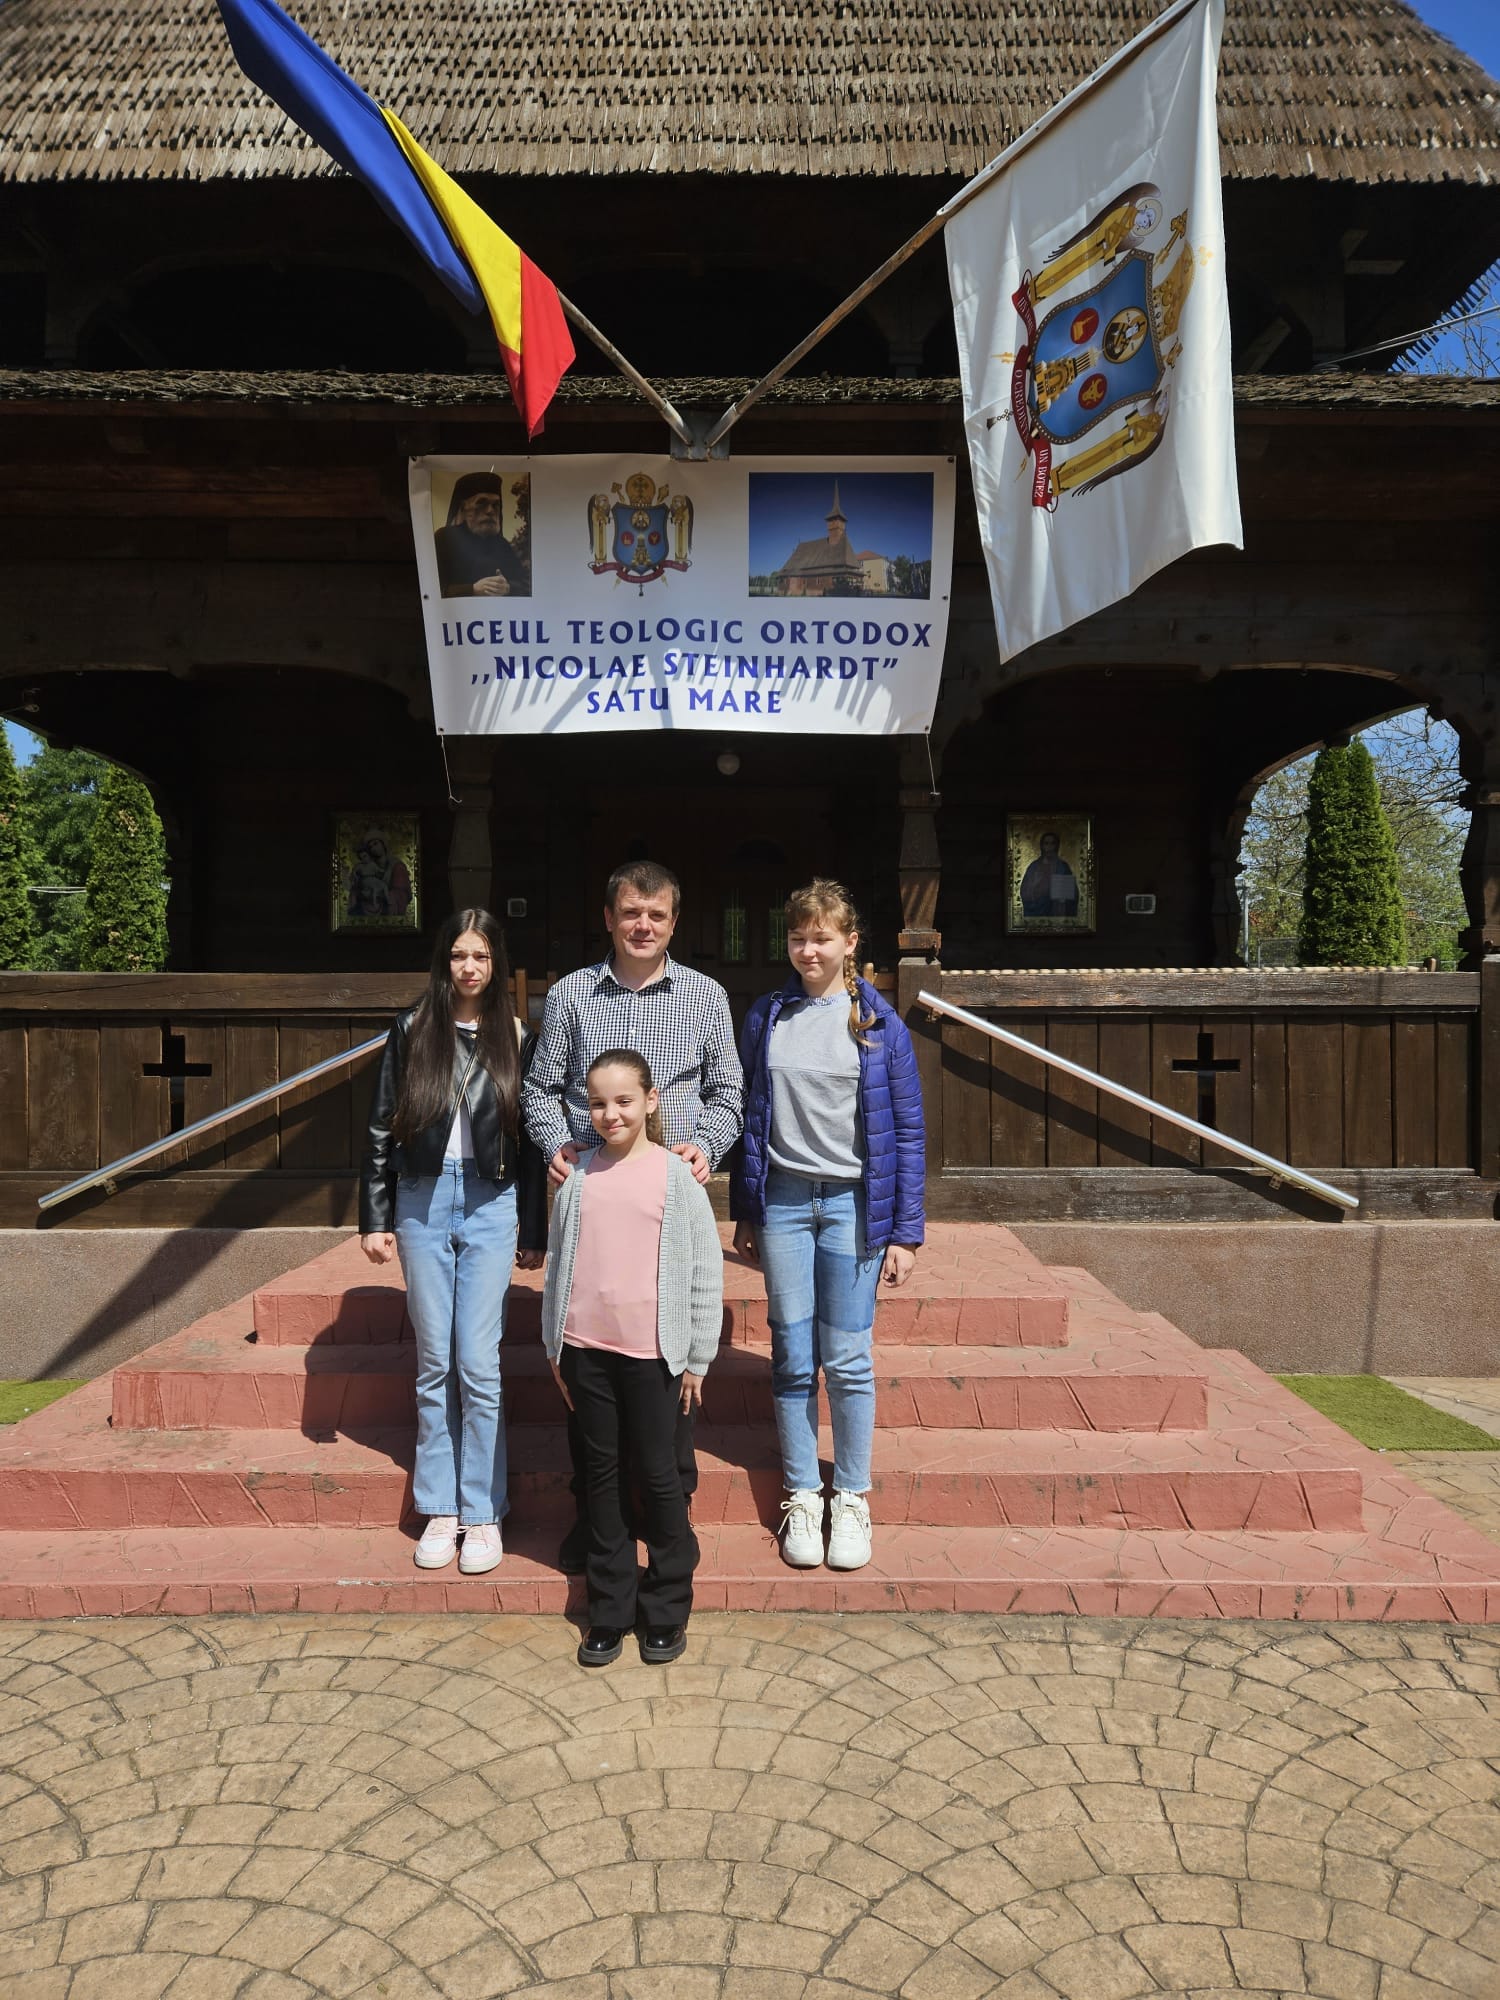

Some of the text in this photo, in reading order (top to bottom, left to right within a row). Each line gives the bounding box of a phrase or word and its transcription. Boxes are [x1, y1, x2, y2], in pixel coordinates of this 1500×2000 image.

[1034, 448, 1049, 498] UN BOTEZ
[442, 618, 932, 647] LICEUL TEOLOGIC ORTODOX
[587, 688, 782, 714] SATU MARE
